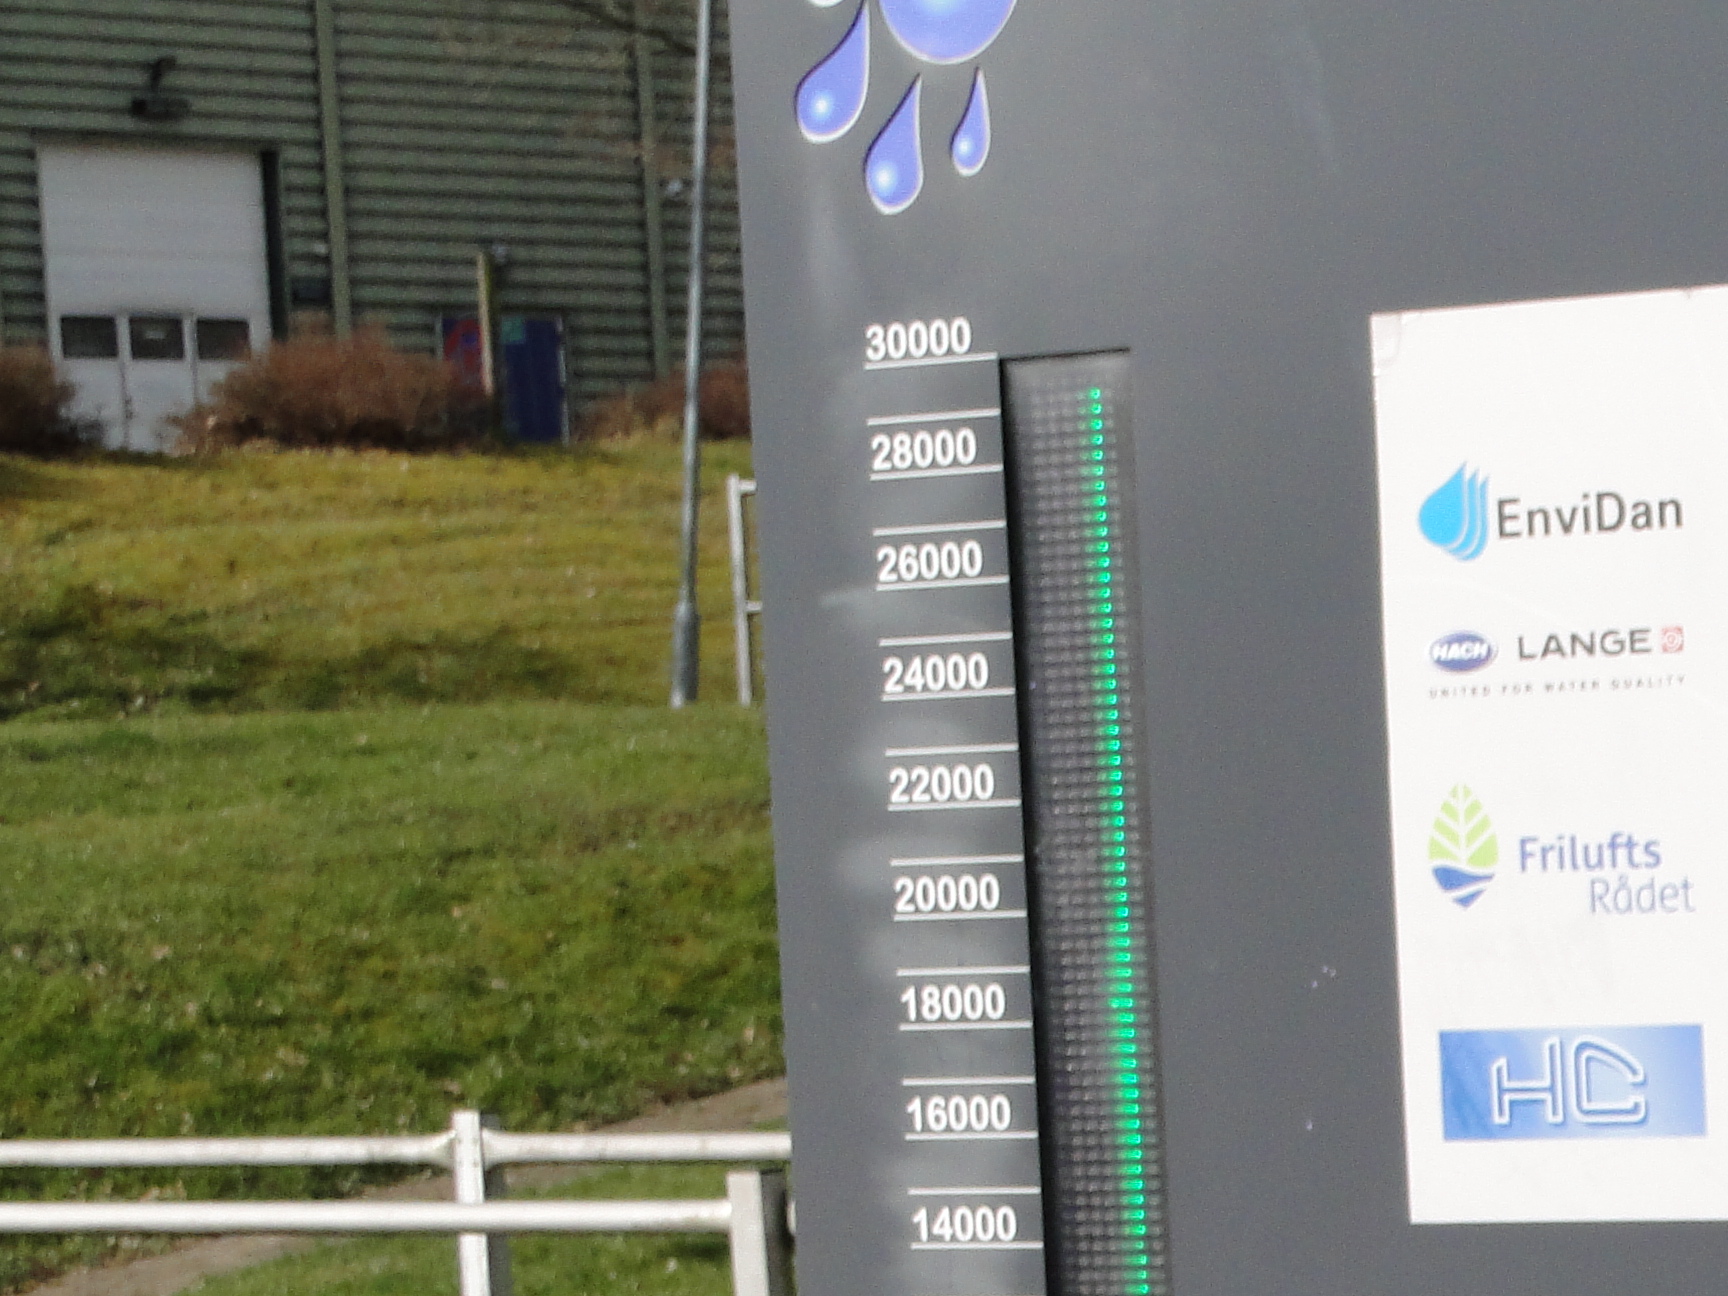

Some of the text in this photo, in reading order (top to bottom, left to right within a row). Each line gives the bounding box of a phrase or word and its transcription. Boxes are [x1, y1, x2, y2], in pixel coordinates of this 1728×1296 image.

[865, 317, 971, 361] 30000
[870, 428, 977, 471] 28000
[1498, 491, 1684, 539] EnviDan
[876, 540, 983, 583] 26000
[1431, 642, 1492, 664] HACH
[1518, 628, 1653, 660] LANGE
[882, 652, 989, 694] 24000
[889, 763, 995, 803] 22000
[1518, 831, 1662, 873] Frilufts
[893, 873, 1001, 913] 20000
[1588, 874, 1697, 914] Rådet
[900, 982, 1006, 1022] 18000
[906, 1094, 1012, 1133] 16000
[912, 1206, 1018, 1242] 14000
